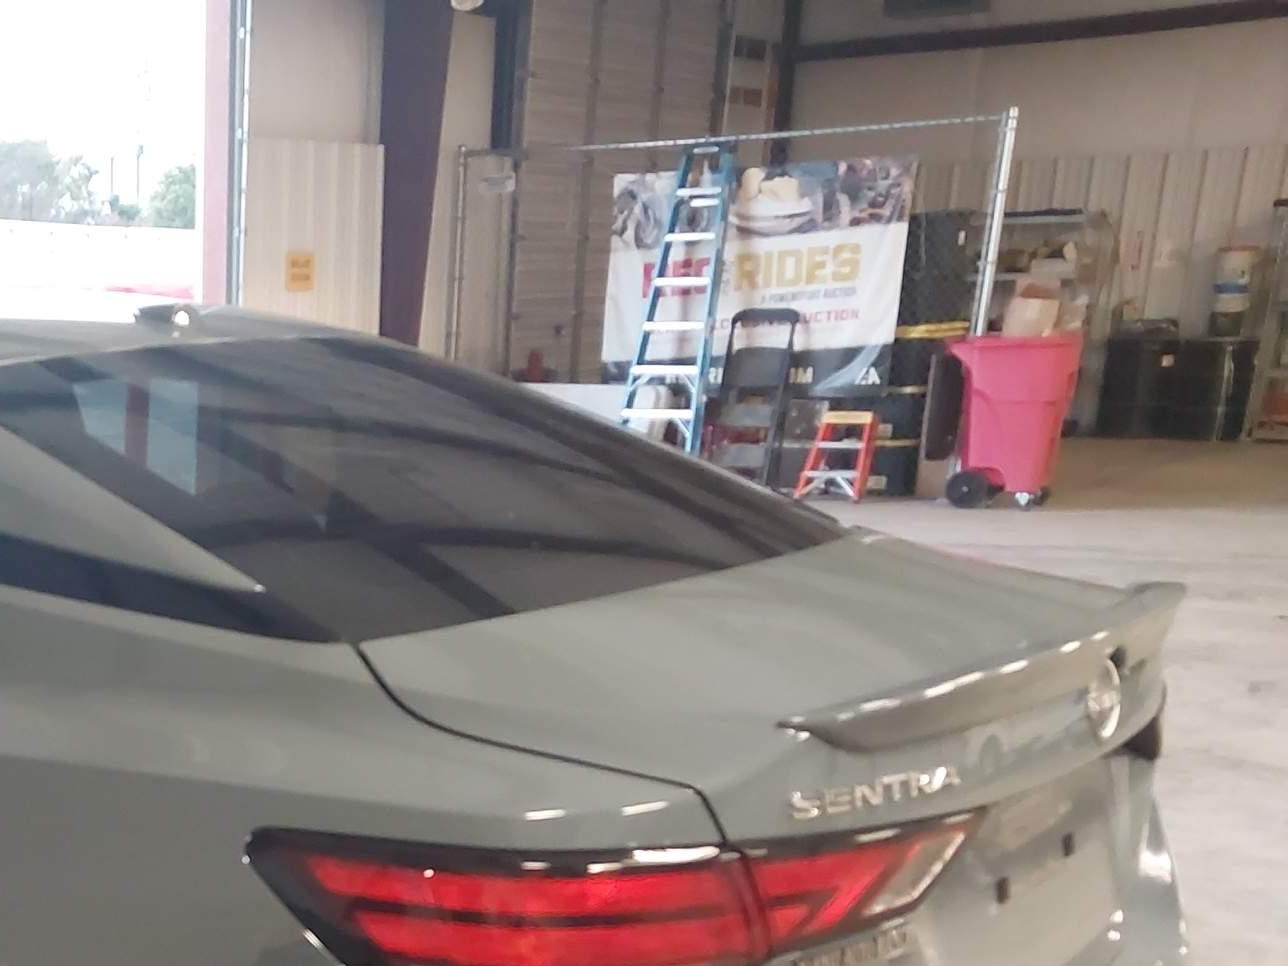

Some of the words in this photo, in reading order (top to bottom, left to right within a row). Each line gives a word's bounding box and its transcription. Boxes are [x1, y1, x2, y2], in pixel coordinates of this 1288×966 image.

[733, 243, 862, 291] RIDES
[799, 308, 861, 328] UCTION
[790, 766, 962, 821] SENTRA
